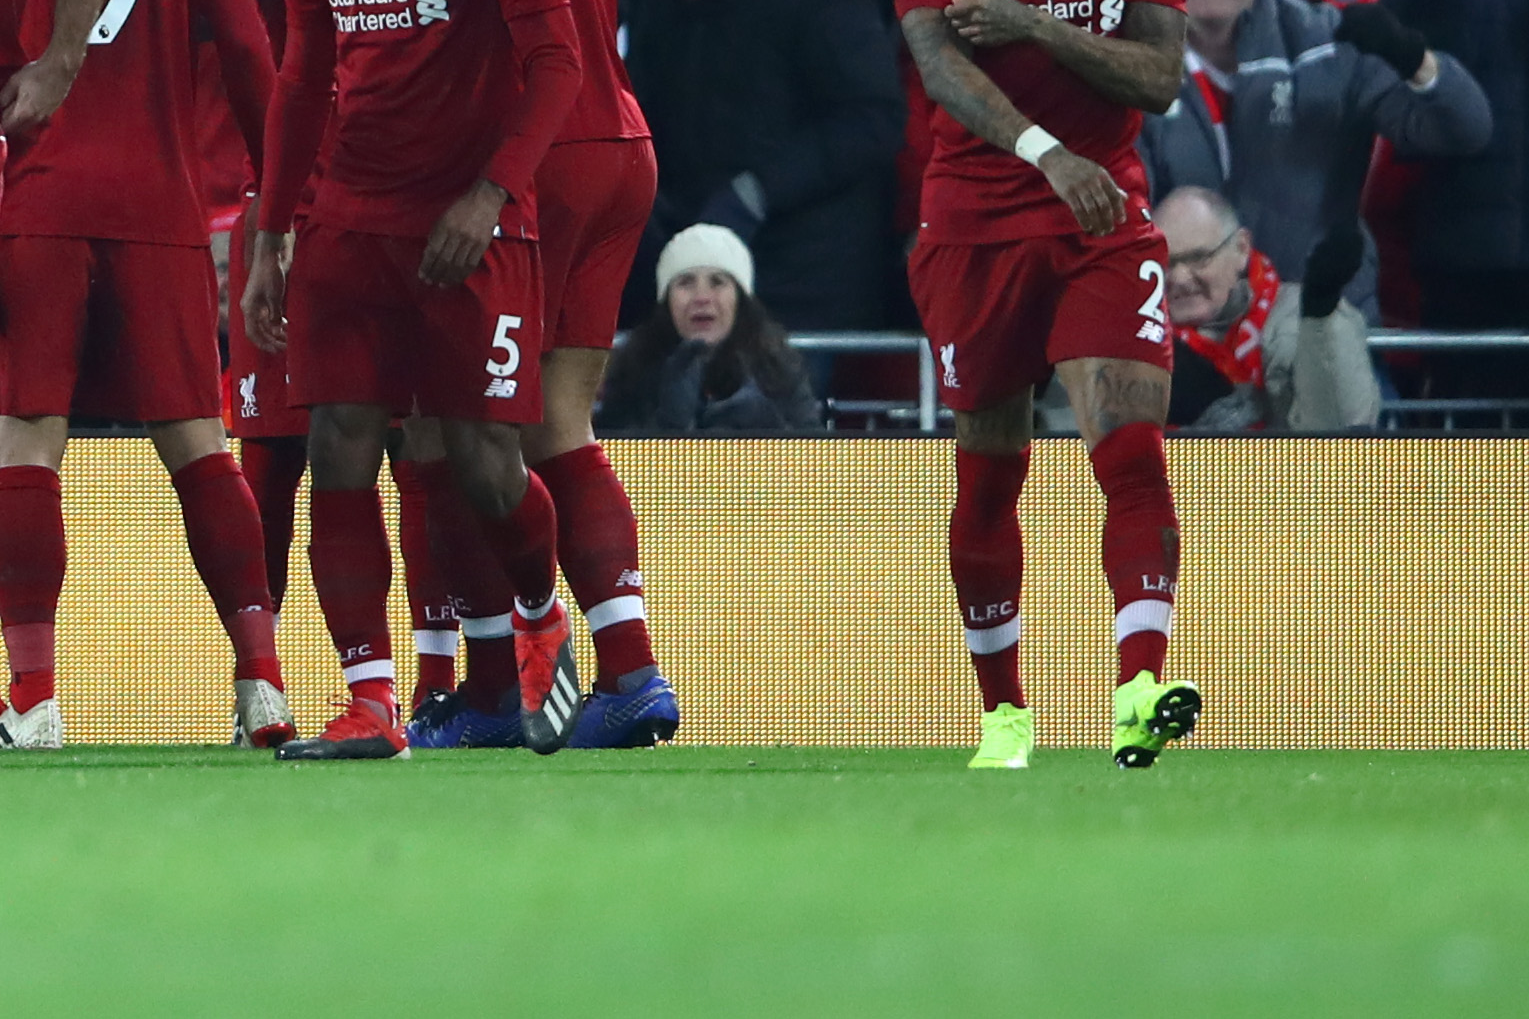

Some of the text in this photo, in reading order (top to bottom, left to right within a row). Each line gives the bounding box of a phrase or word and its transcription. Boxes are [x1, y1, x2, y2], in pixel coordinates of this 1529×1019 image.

[332, 7, 413, 33] hartered
[1137, 259, 1166, 323] 2
[485, 314, 522, 377] 5
